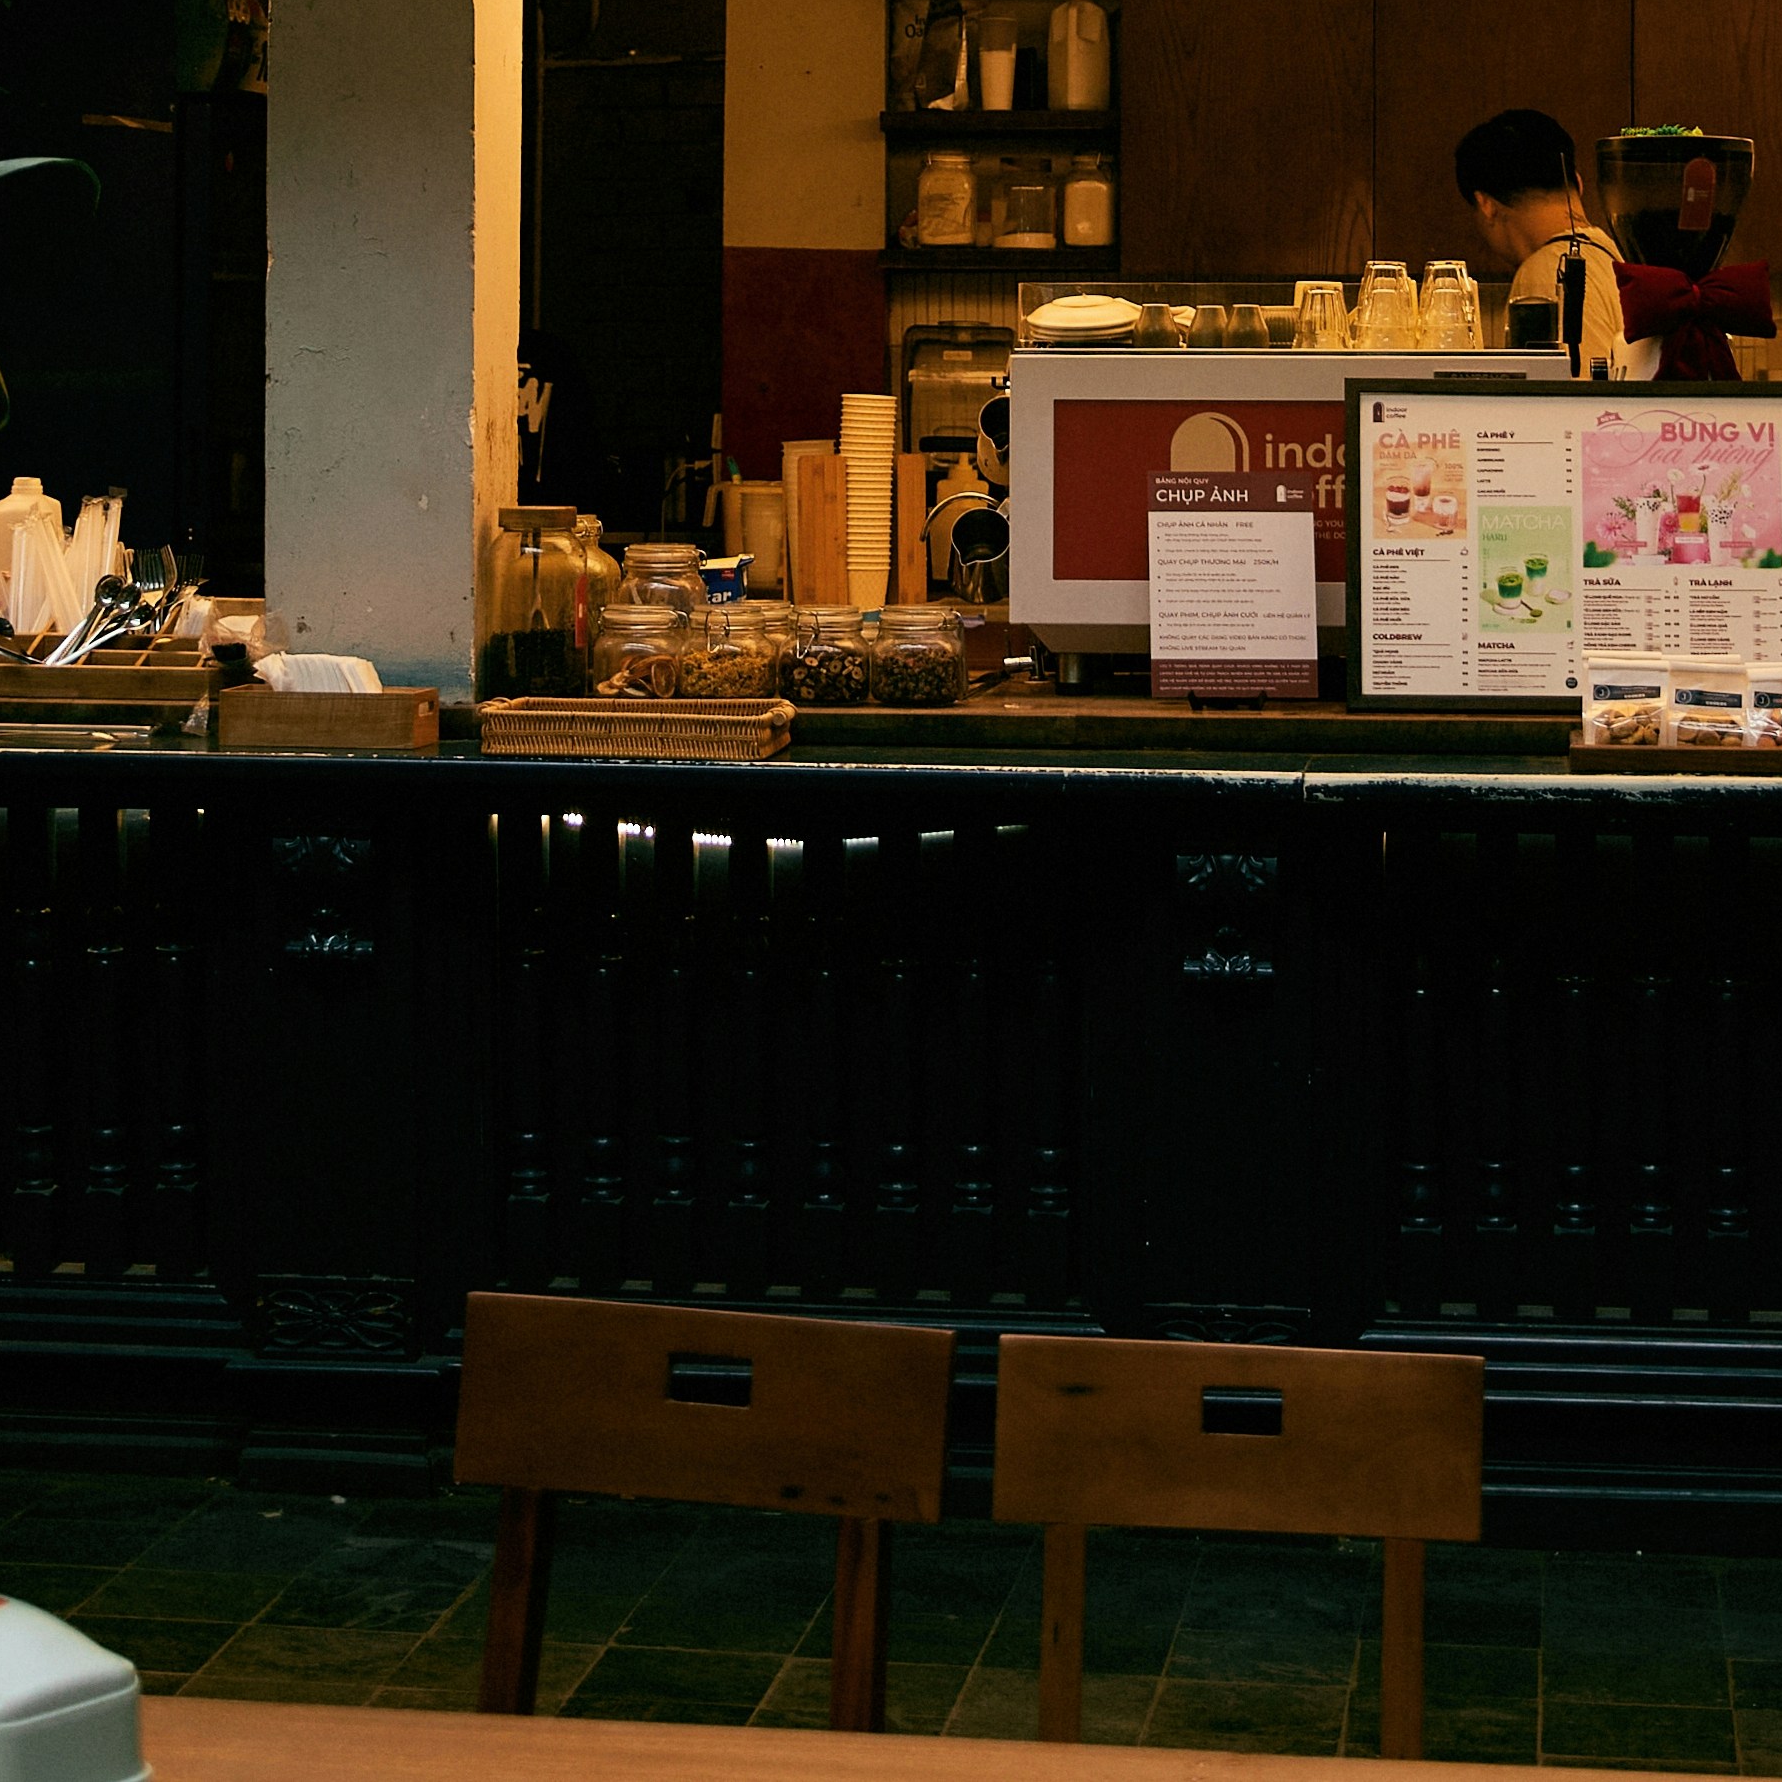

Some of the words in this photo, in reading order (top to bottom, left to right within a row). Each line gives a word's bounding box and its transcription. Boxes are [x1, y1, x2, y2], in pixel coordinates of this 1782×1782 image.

[1379, 428, 1410, 449] CÀ
[1417, 428, 1461, 450] PHÊ
[1476, 431, 1489, 439] CÀ
[1490, 430, 1508, 439] PHÊ
[1747, 422, 1775, 448] VỊ
[1156, 476, 1177, 485] BẢNG
[1178, 476, 1193, 486] NỘI
[1156, 489, 1206, 506] CHỤP
[1210, 485, 1249, 503] ẢNH
[1481, 514, 1566, 531] MATCHA
[1372, 548, 1386, 557] CÀ
[1386, 547, 1404, 557] PHÊ
[1405, 547, 1426, 559] VIỆT
[1582, 577, 1603, 587] TRÀ
[1603, 576, 1622, 587] SỮA
[1688, 577, 1709, 587] TRÀ
[1709, 578, 1733, 589] LẠNH
[1372, 633, 1423, 641] COLDBREW
[1477, 642, 1516, 650] MATCHA
